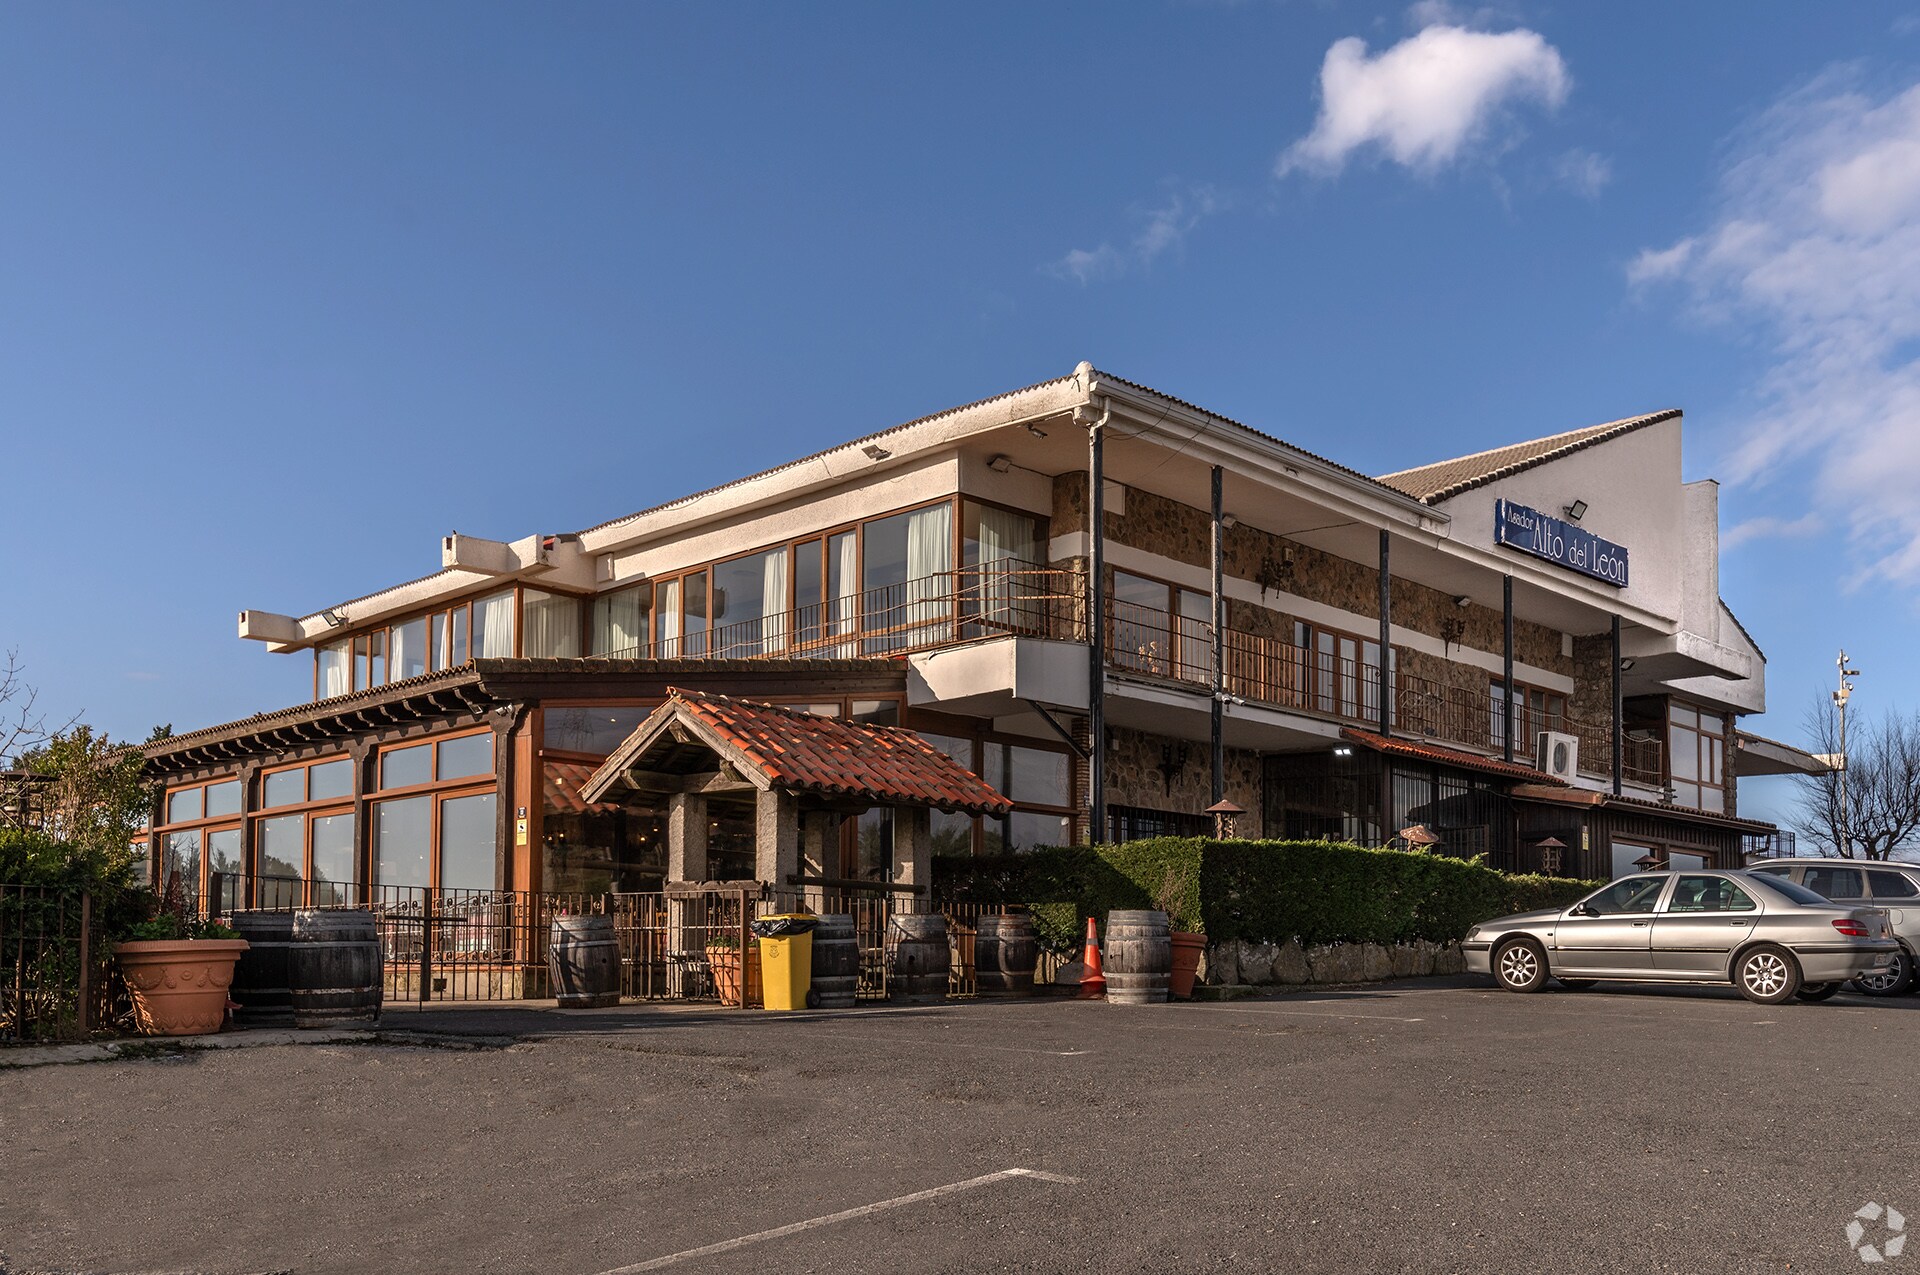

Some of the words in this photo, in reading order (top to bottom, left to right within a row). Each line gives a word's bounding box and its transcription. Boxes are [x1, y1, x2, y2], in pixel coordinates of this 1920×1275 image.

[1507, 506, 1534, 530] Asador
[1533, 517, 1564, 559] Alto
[1568, 538, 1588, 569] del
[1592, 540, 1626, 582] León
